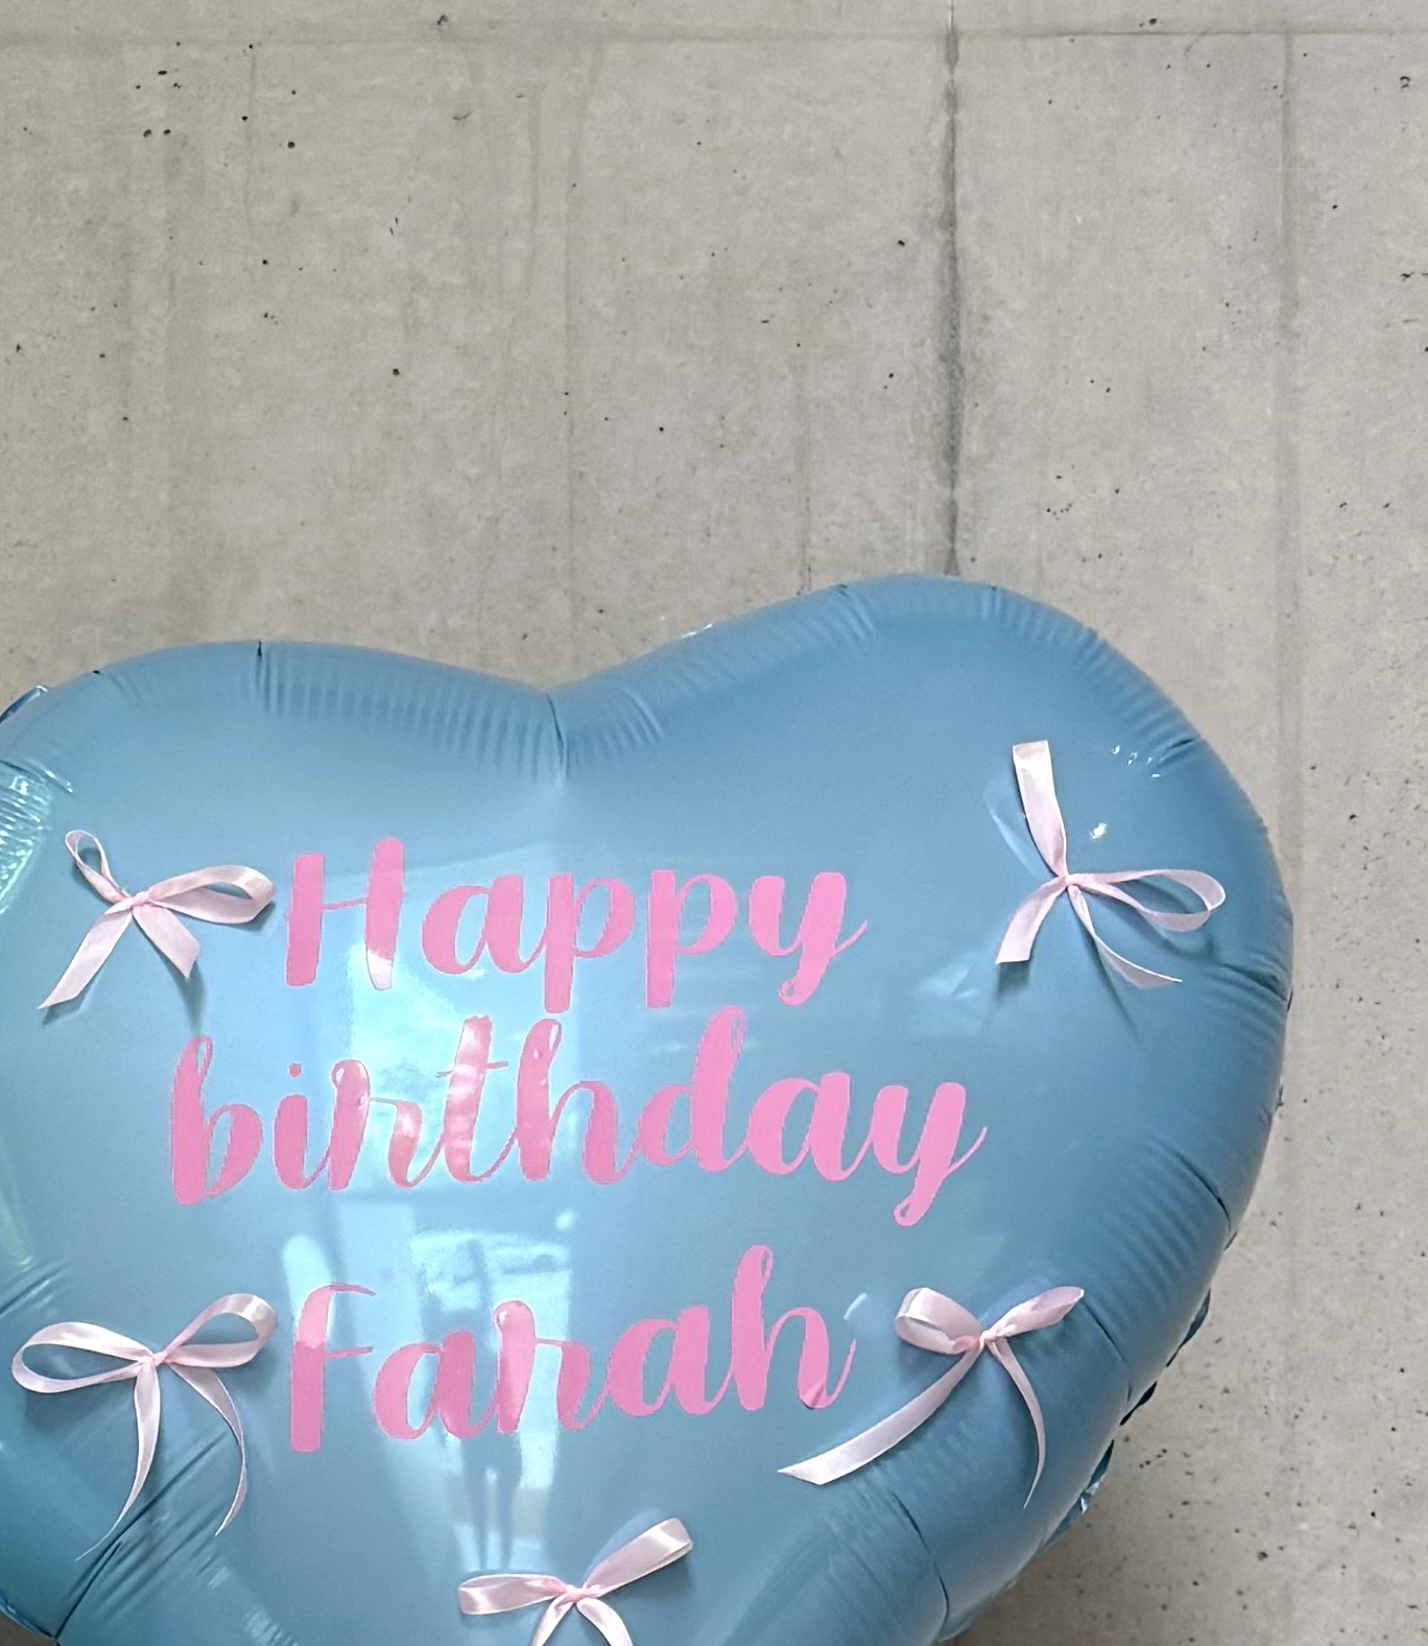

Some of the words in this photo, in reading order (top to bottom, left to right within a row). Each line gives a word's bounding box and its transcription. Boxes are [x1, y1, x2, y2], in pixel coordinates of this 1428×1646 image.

[286, 838, 867, 1014] Happy
[170, 1005, 987, 1228] birthday
[289, 1245, 856, 1453] Farah
